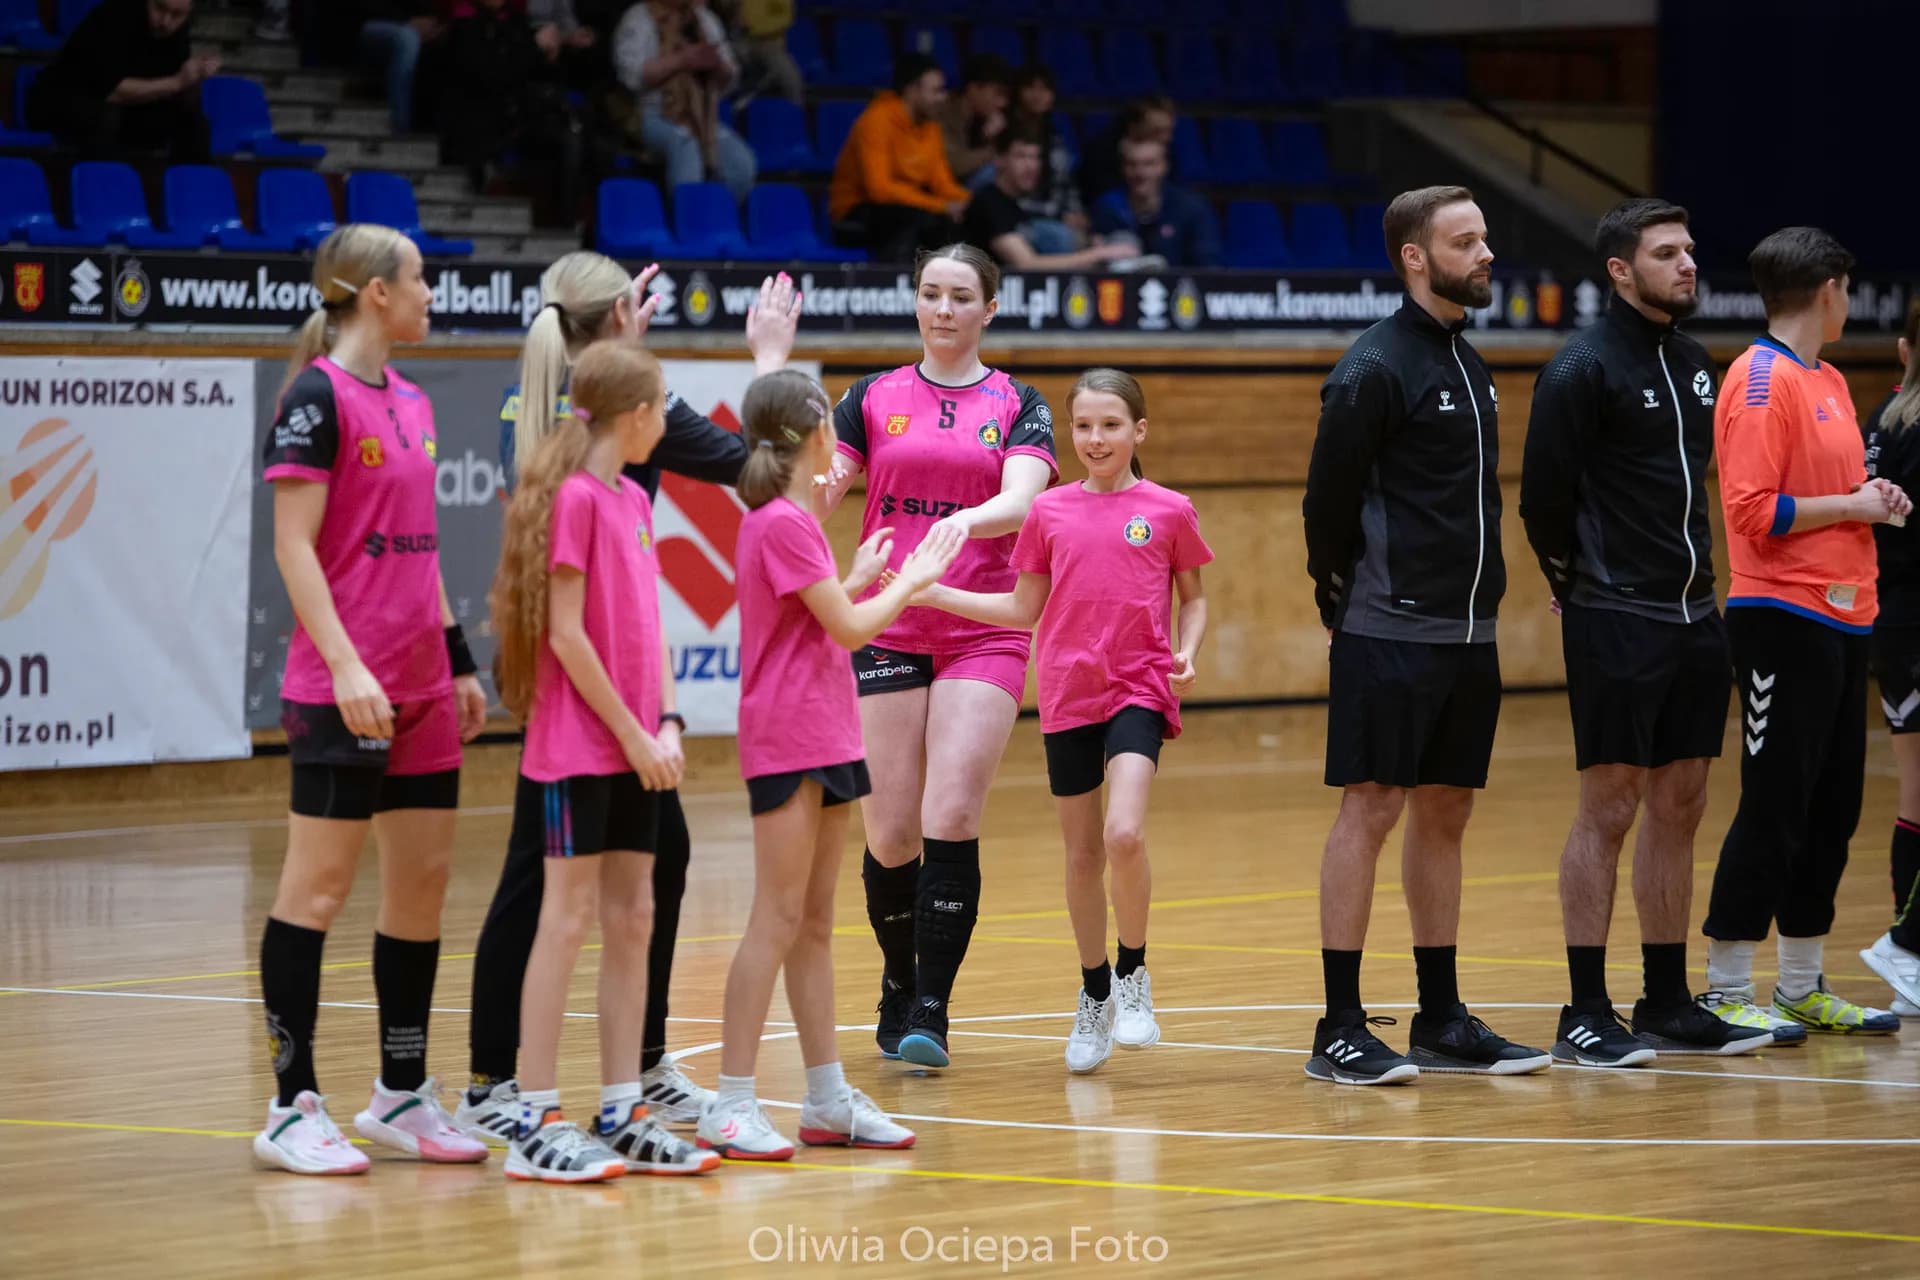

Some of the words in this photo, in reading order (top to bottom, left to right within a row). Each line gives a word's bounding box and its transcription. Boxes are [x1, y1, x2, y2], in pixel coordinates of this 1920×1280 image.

[0, 380, 40, 405] UN
[51, 380, 174, 405] HORIZON
[182, 381, 234, 406] S.A.
[938, 399, 957, 429] 5
[887, 422, 904, 435] CK
[902, 497, 975, 518] SUZ
[0, 712, 114, 748] izon.pl
[933, 900, 963, 911] SELECT
